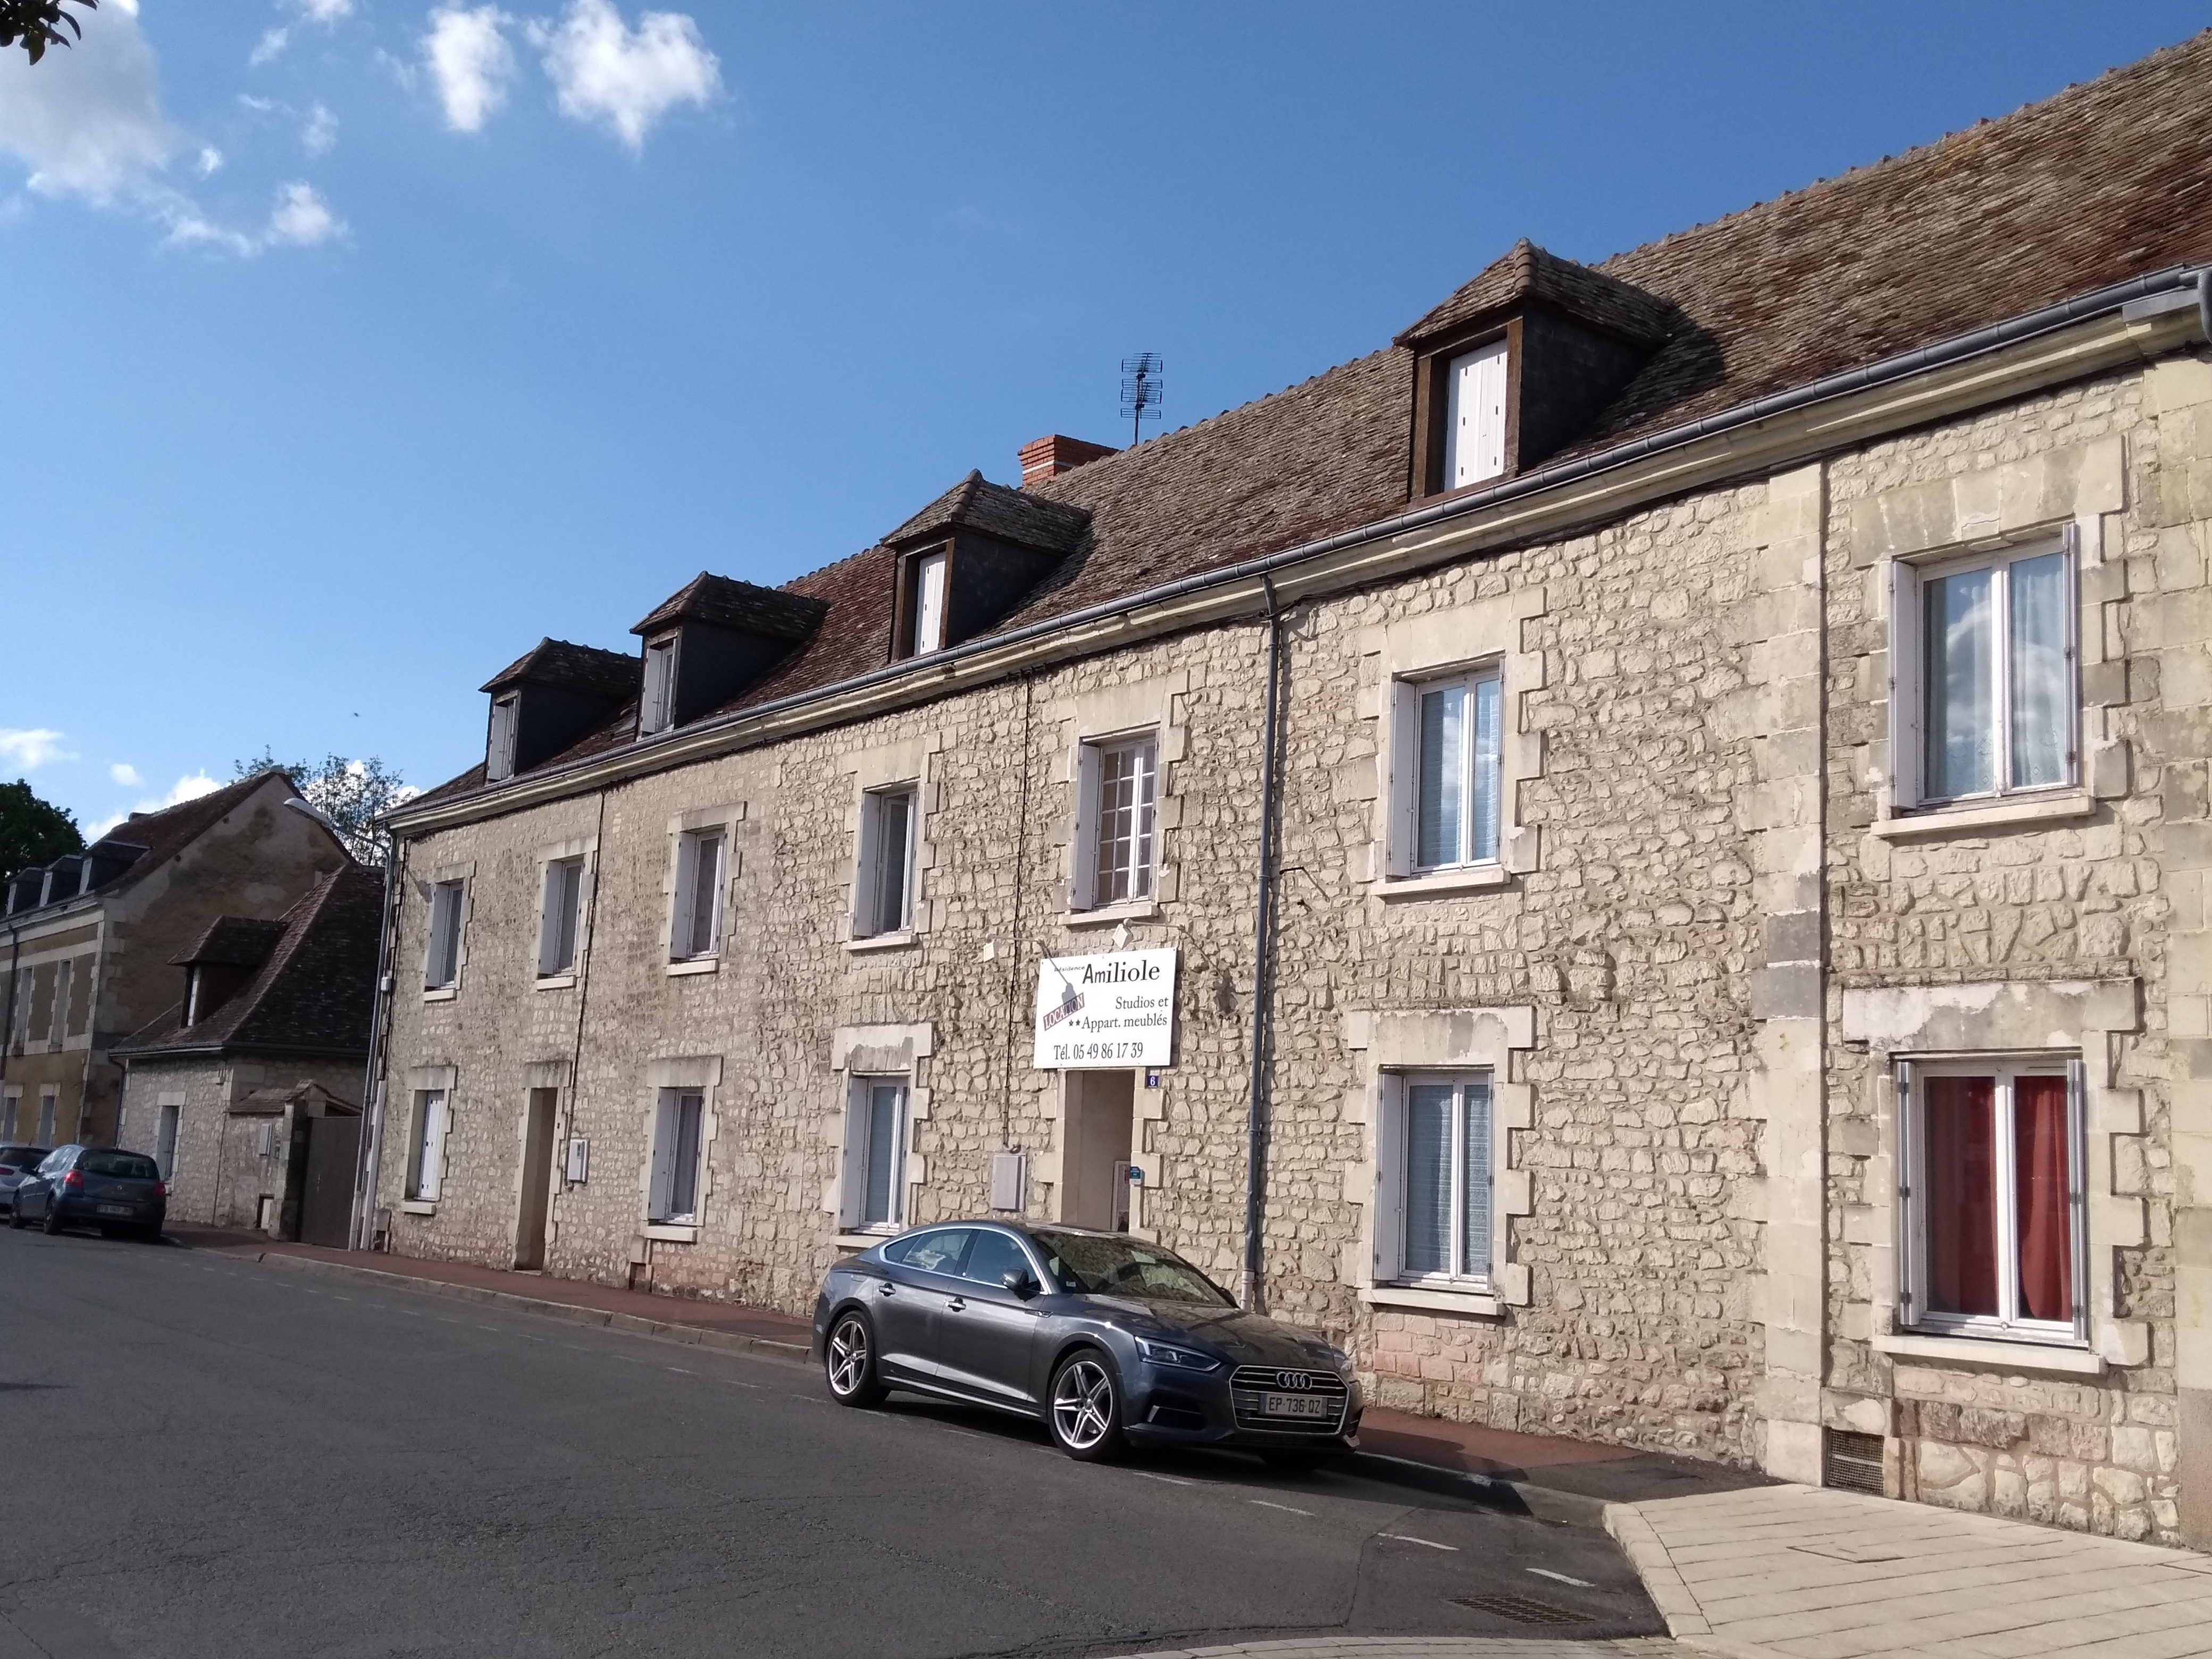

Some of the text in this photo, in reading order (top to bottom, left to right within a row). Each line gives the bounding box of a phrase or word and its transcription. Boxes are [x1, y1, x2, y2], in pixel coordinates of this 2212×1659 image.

[1082, 959, 1160, 984] Amiliole
[1116, 995, 1169, 1009] Studios et
[1044, 994, 1084, 1030] LOCATION
[1082, 1013, 1168, 1033] Appart. meublés
[1054, 1042, 1143, 1060] Tél. 05 49 86 17 39
[1150, 1076, 1155, 1086] 6
